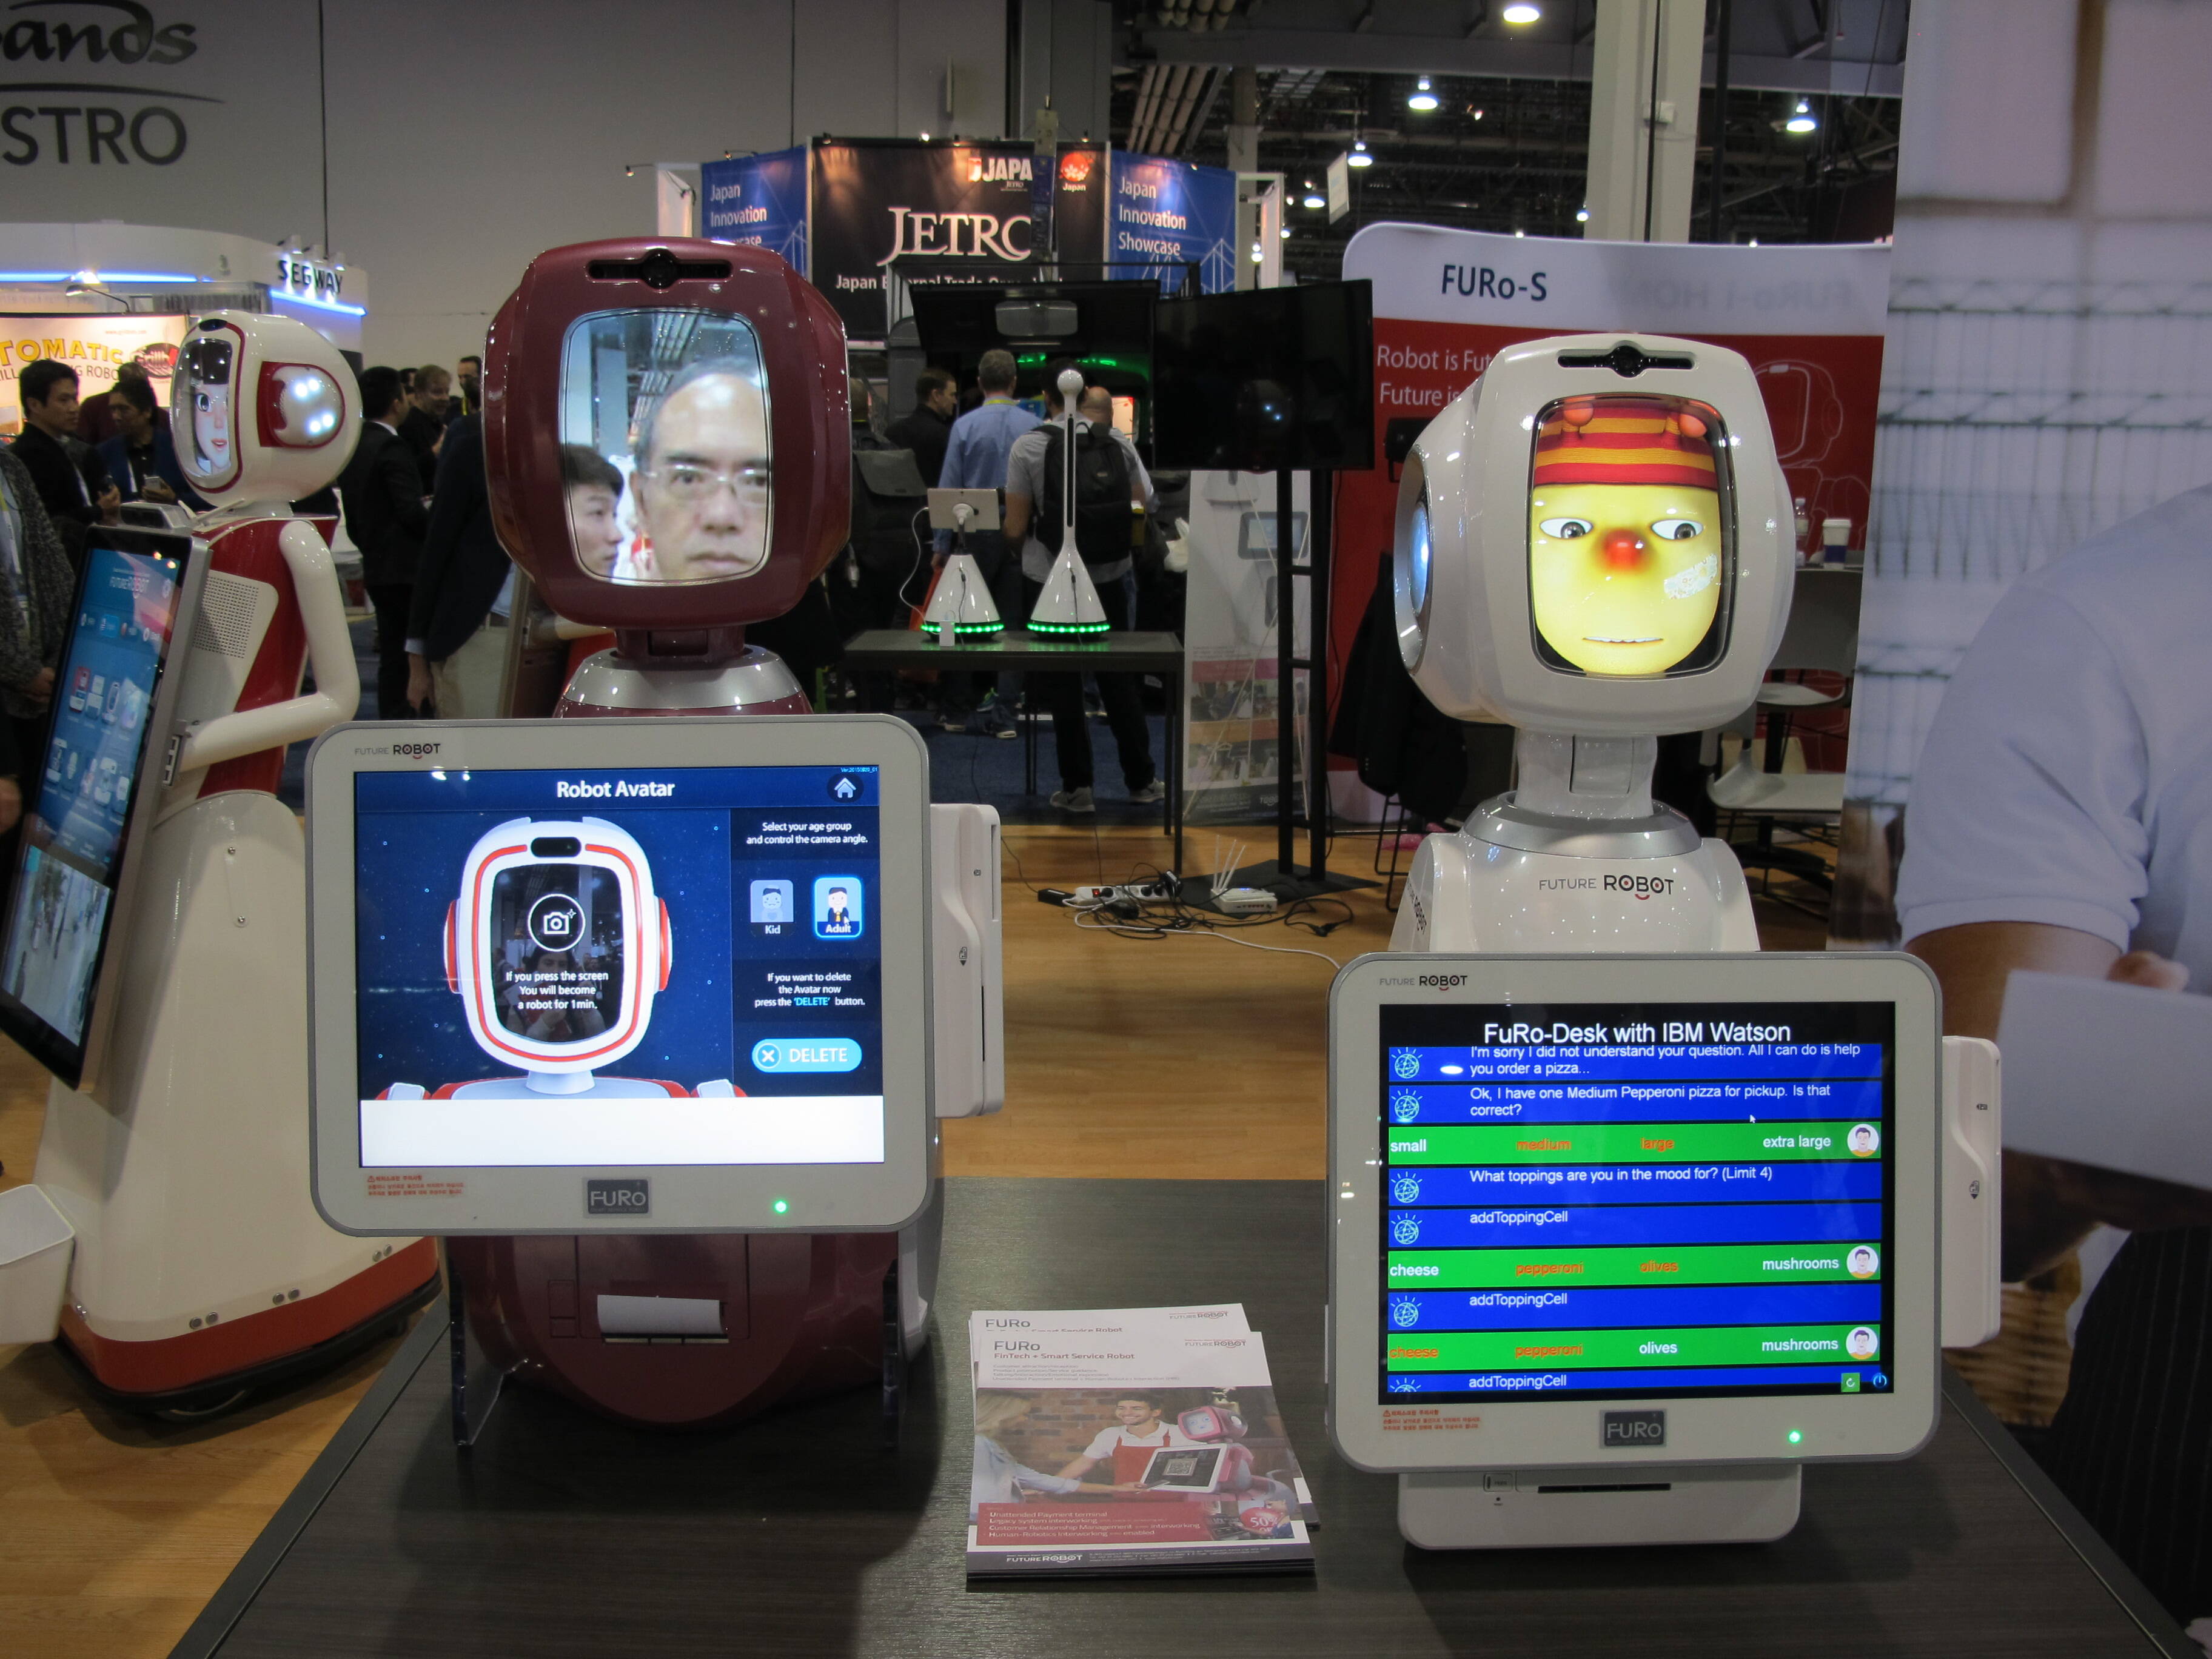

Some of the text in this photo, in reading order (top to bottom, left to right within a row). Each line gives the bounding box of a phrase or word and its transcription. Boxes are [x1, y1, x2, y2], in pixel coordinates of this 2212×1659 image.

[982, 157, 1033, 183] JAPA
[710, 184, 741, 204] Japan
[1063, 183, 1087, 192] Japan
[1119, 176, 1156, 200] Japan
[711, 205, 768, 228] Innovation
[1119, 204, 1186, 230] Innovation
[1119, 232, 1180, 256] Showcase
[278, 260, 343, 293] SEGWAY
[836, 275, 877, 292] Japan
[1441, 264, 1547, 301] FURo-S
[1377, 345, 1493, 371] Robot is Fut
[87, 366, 118, 380] ROBO
[1380, 382, 1443, 406] Future
[354, 743, 441, 757] FUTURE ROBOT
[557, 780, 675, 798] Robot Avatar
[762, 821, 851, 833] Select your age group
[746, 834, 868, 846] and control the camera angle.
[1539, 874, 1674, 895] FUTURE ROBOT
[765, 925, 780, 934] Kid
[826, 924, 851, 934] Adult
[506, 971, 609, 982] If you press the screen
[768, 973, 775, 981] If
[775, 974, 791, 984] you
[825, 972, 851, 981] delete
[1419, 975, 1468, 987] ROBOT
[519, 985, 597, 995] You will become
[779, 985, 793, 994] the
[794, 985, 821, 994] Avatar
[526, 1000, 552, 1010] robot
[554, 1000, 569, 1009] for
[754, 999, 776, 1008] press
[778, 997, 792, 1006] the
[834, 997, 866, 1005] button.
[1484, 1022, 1791, 1044] FuRo-Desk with IBM Watson
[789, 1048, 848, 1062] DELETE
[1470, 1045, 1490, 1057] I'm
[1493, 1046, 1524, 1061] sorry
[1528, 1045, 1532, 1057] I
[1537, 1045, 1556, 1057] did
[1560, 1046, 1580, 1057] not
[1583, 1044, 1654, 1057] understand
[1658, 1047, 1684, 1059] your
[1689, 1045, 1744, 1059] question.
[1748, 1044, 1763, 1056] All
[1775, 1046, 1797, 1056] can
[1801, 1044, 1817, 1056] do
[1820, 1044, 1830, 1055] is
[1834, 1043, 1860, 1057] help
[1470, 1063, 1589, 1078] you order a pizza...
[1470, 1084, 1831, 1101] Ok, I have one Medium Pepperoni pizza for pickup. Is that
[1470, 1103, 1521, 1116] correct?
[1390, 1136, 1831, 1152] small medium large extra large
[1470, 1166, 1773, 1184] What toppings are you in the mood for? (Limit 4)
[1470, 1210, 1568, 1225] addToppingCell
[1390, 1257, 1840, 1276] cheese pepperoni olives mushrooms
[1469, 1293, 1567, 1308] addToppingCell
[985, 1319, 1031, 1327] FURo
[994, 1341, 1041, 1350] FURo
[1389, 1338, 1838, 1358] cheese pepperoni olives mushrooms
[1469, 1375, 1567, 1390] addToppingCell
